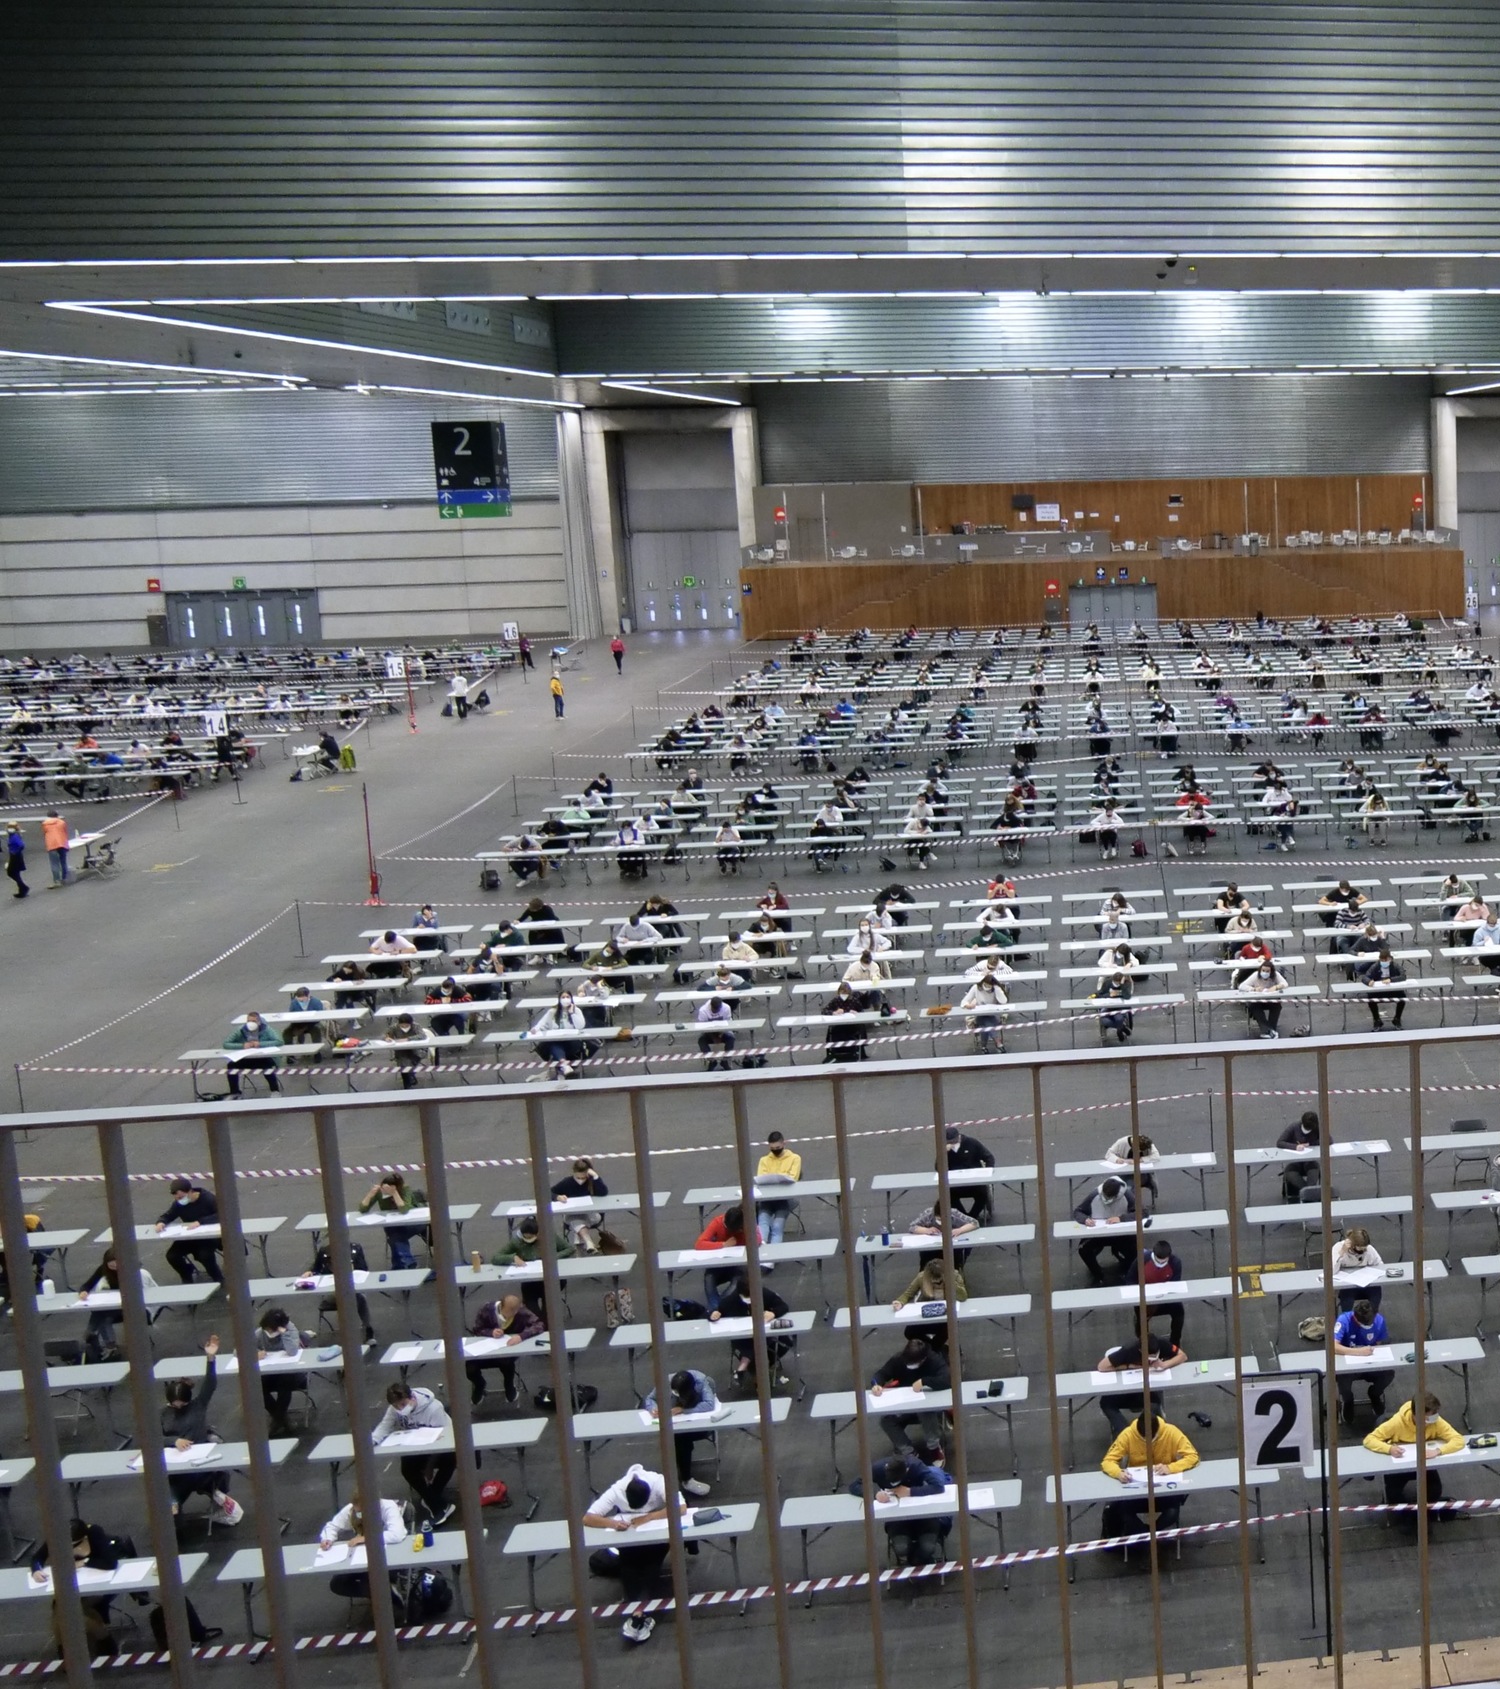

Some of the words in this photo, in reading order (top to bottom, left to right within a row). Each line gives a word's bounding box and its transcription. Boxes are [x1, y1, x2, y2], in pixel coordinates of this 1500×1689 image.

[453, 427, 472, 455] 2
[388, 662, 403, 676] 1.5
[207, 717, 225, 735] 1.4
[1255, 1389, 1301, 1466] 2
